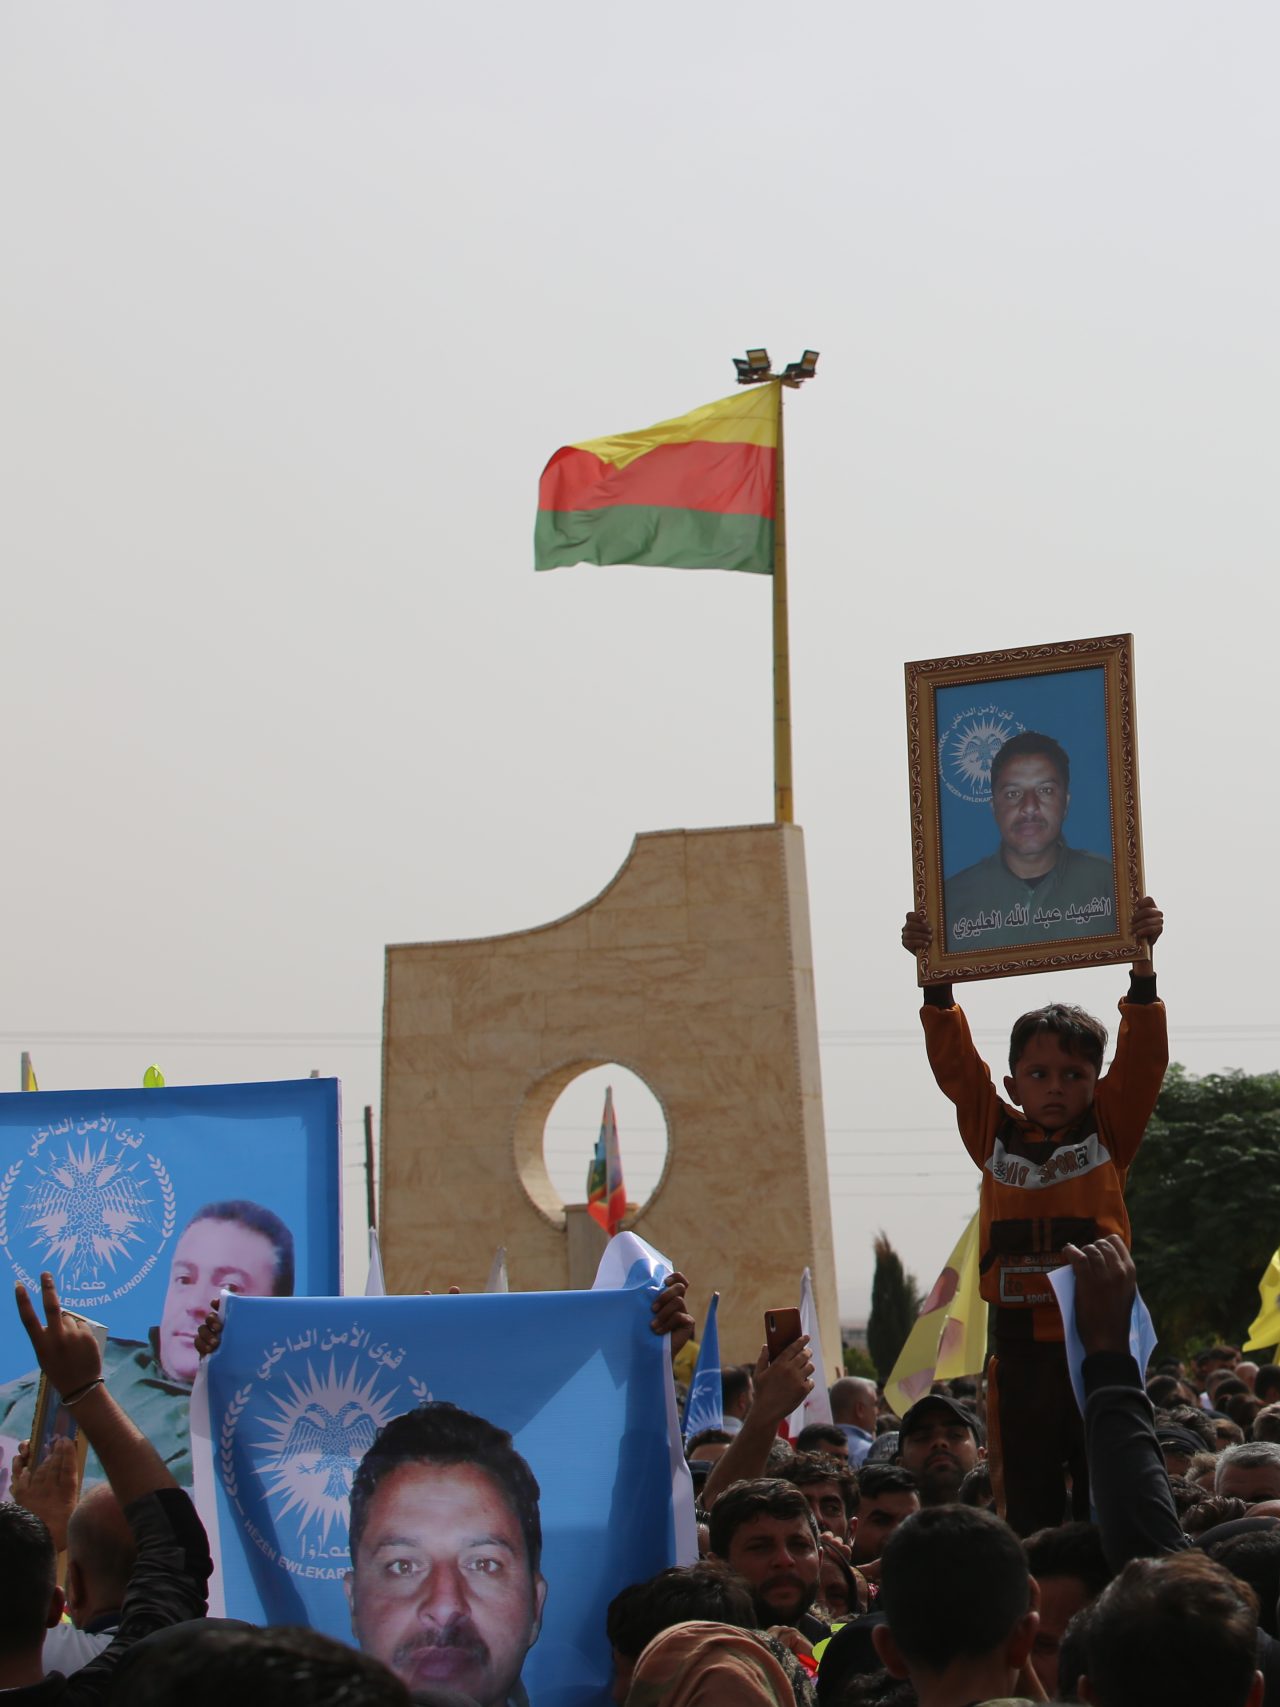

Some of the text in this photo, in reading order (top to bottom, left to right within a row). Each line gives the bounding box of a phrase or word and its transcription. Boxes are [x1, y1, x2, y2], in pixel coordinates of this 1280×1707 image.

[953, 897, 1112, 940] الشهيد عبد الله العليوي
[27, 1112, 145, 1158] قوى الأمن الداخلي
[58, 1294, 112, 1308] LEKARIYA
[256, 1321, 407, 1380] قوى الأمن الداخلي
